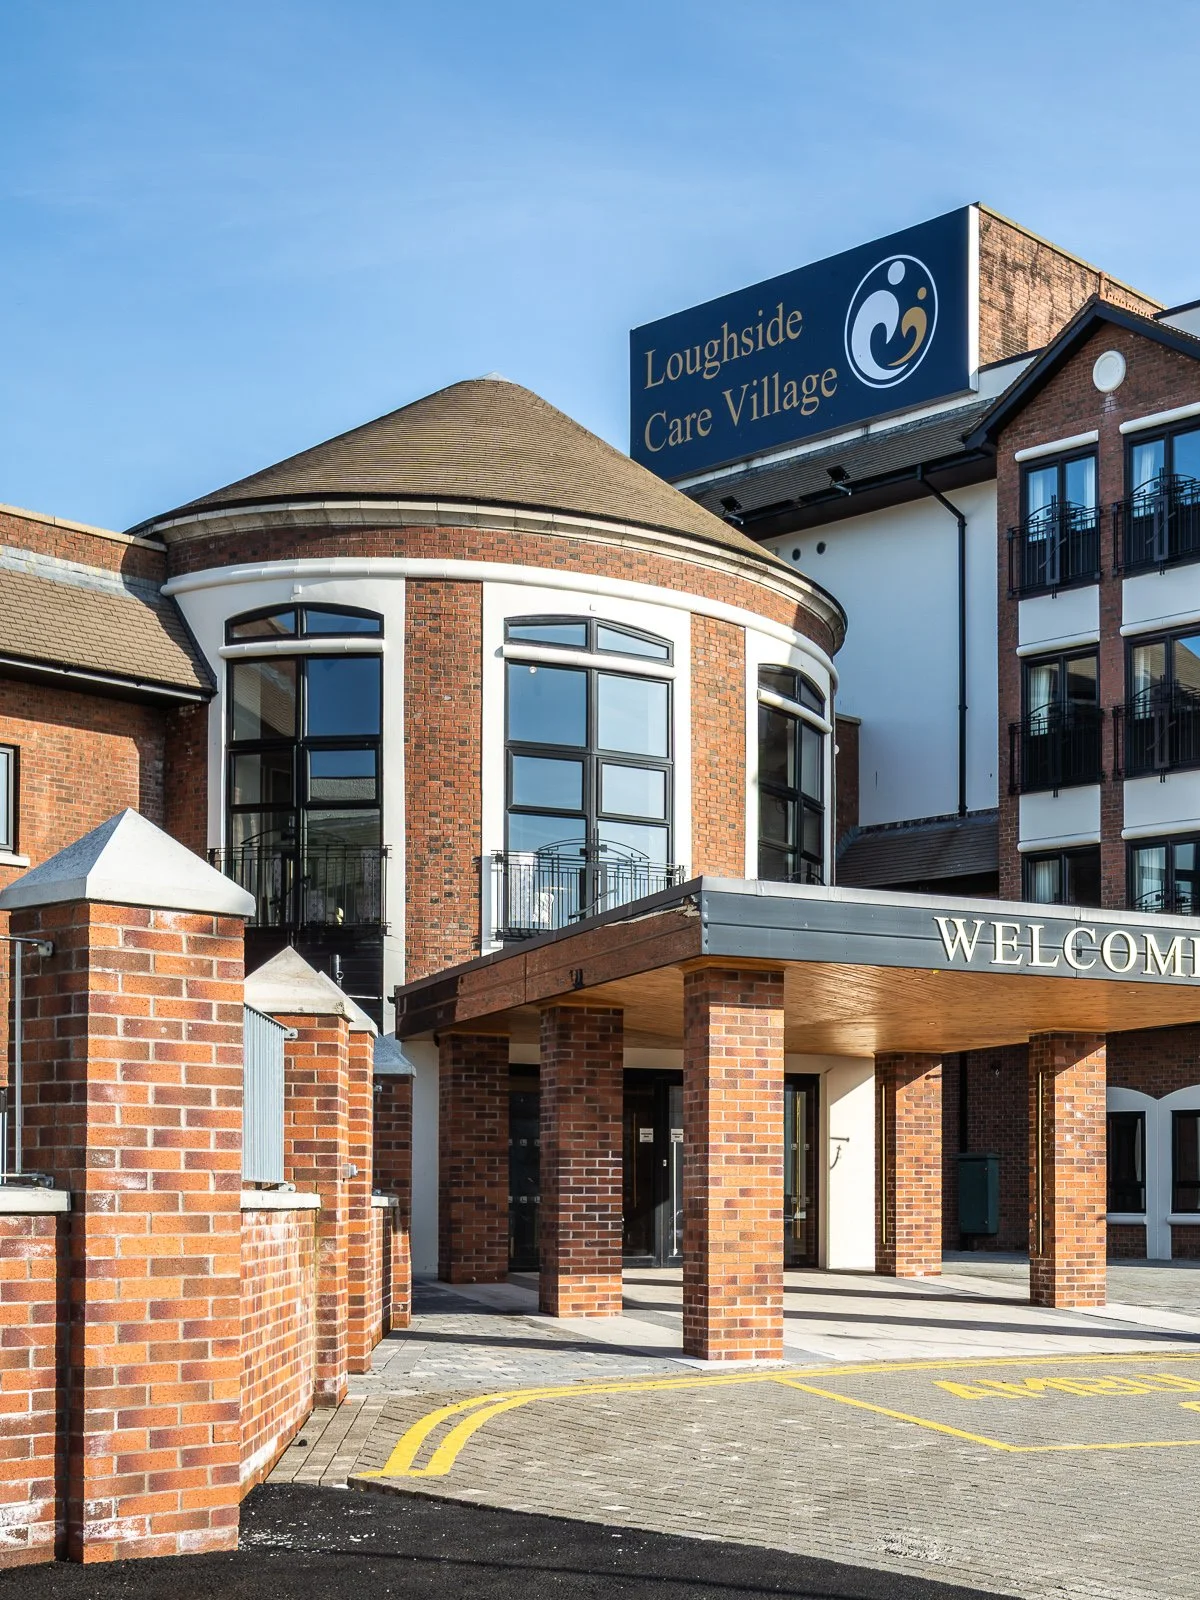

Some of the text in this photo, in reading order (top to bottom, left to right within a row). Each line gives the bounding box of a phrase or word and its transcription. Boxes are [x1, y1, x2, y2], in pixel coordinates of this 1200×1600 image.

[644, 302, 803, 389] Loughside
[645, 367, 838, 452] Care Village
